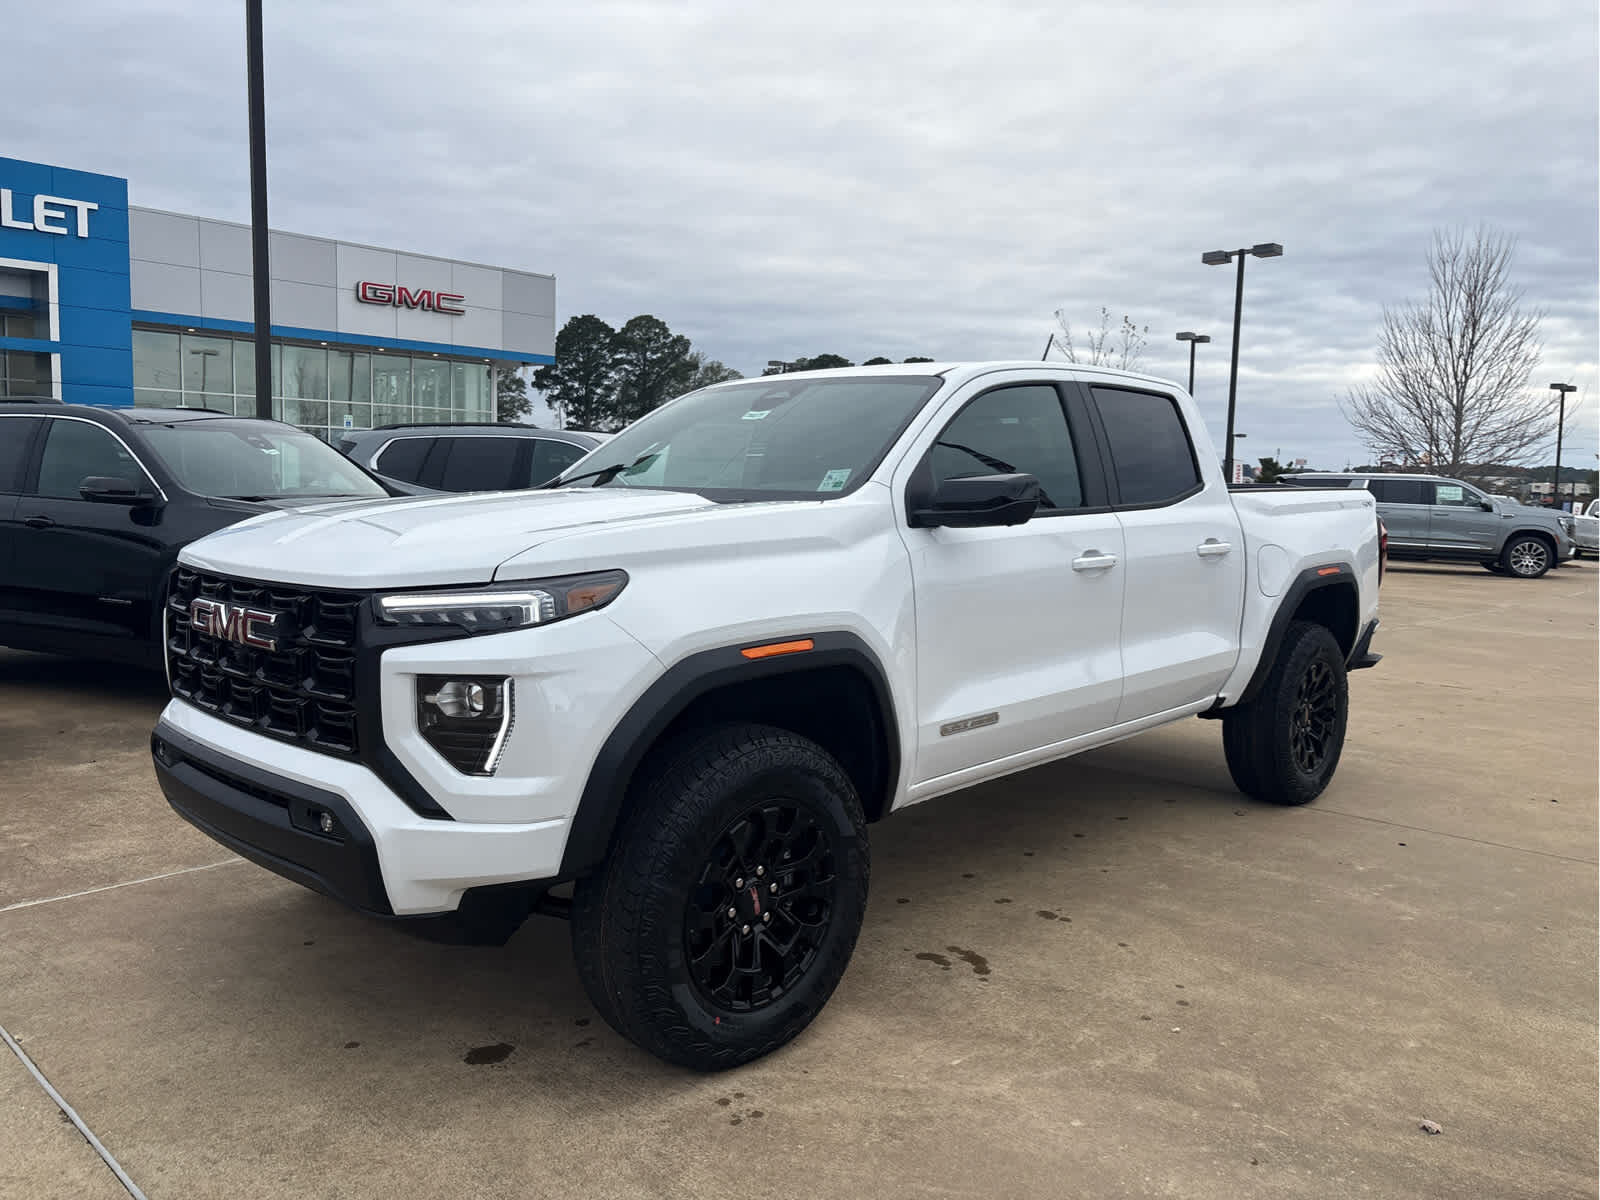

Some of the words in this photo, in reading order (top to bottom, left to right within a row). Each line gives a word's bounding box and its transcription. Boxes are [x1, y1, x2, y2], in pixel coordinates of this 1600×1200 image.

[0, 188, 98, 238] LET
[358, 280, 465, 315] GMC
[190, 598, 277, 652] GMC
